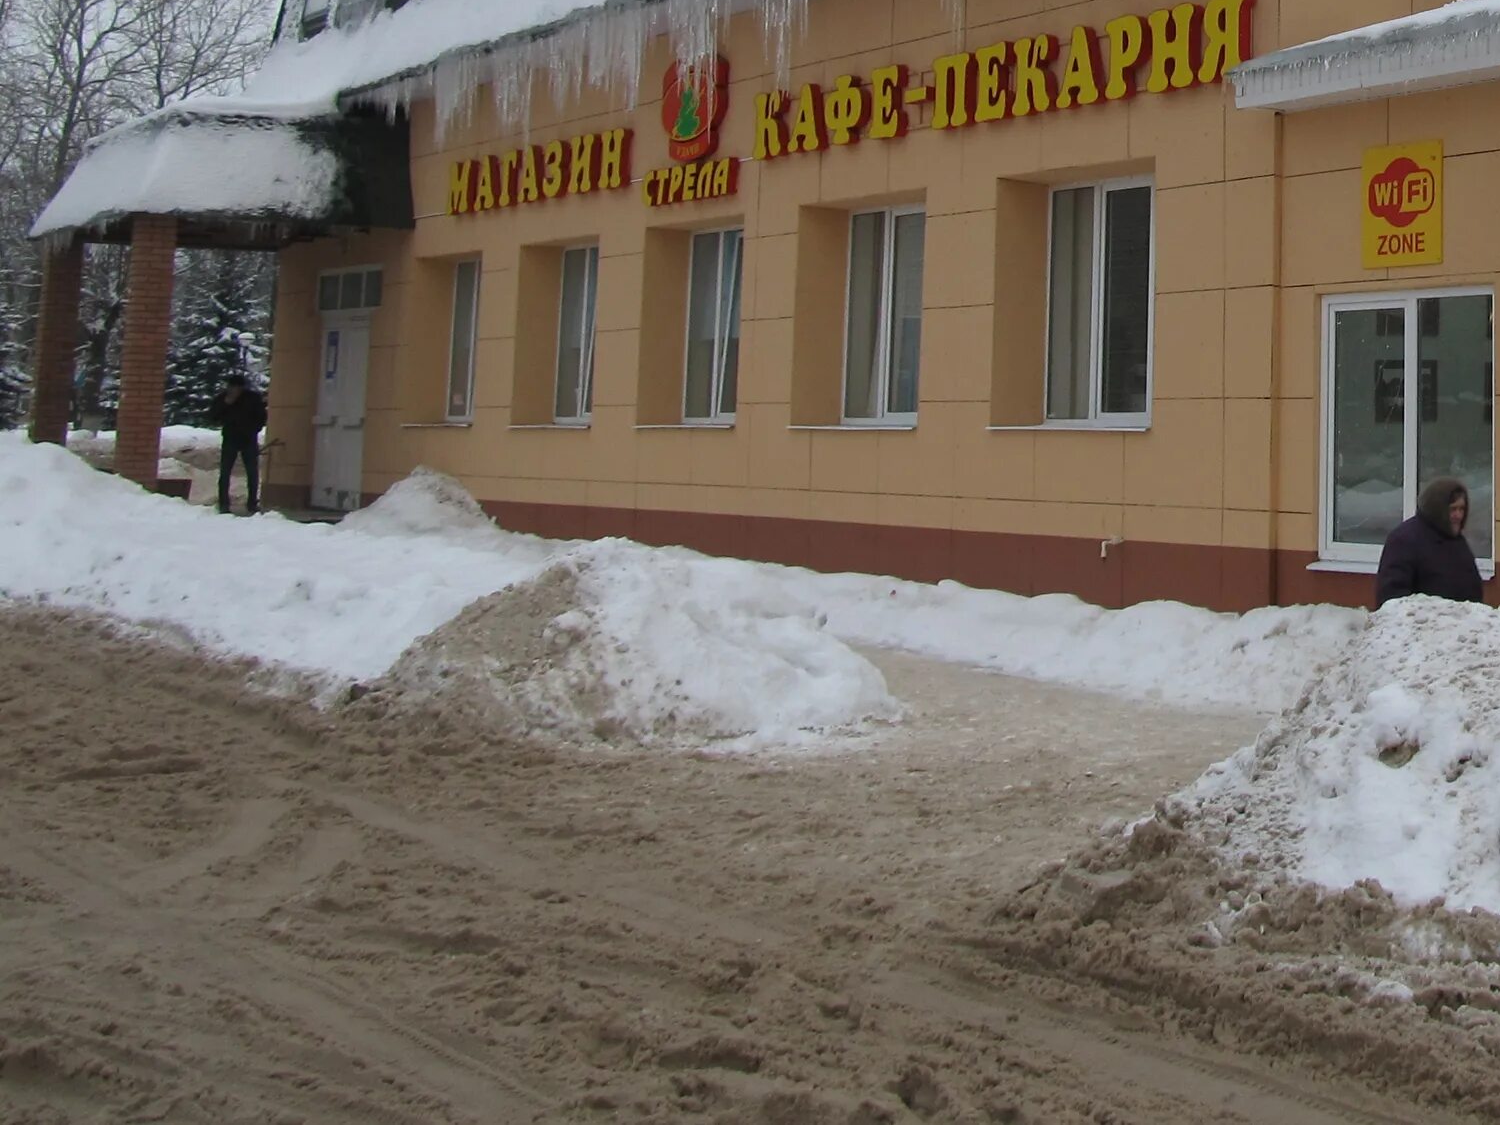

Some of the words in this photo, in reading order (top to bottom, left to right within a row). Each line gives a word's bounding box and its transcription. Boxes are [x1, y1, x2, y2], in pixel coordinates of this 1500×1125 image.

[447, 127, 630, 215] МАГАЗИН
[642, 157, 732, 209] СТРЕЛА
[1377, 231, 1426, 256] ZONE
